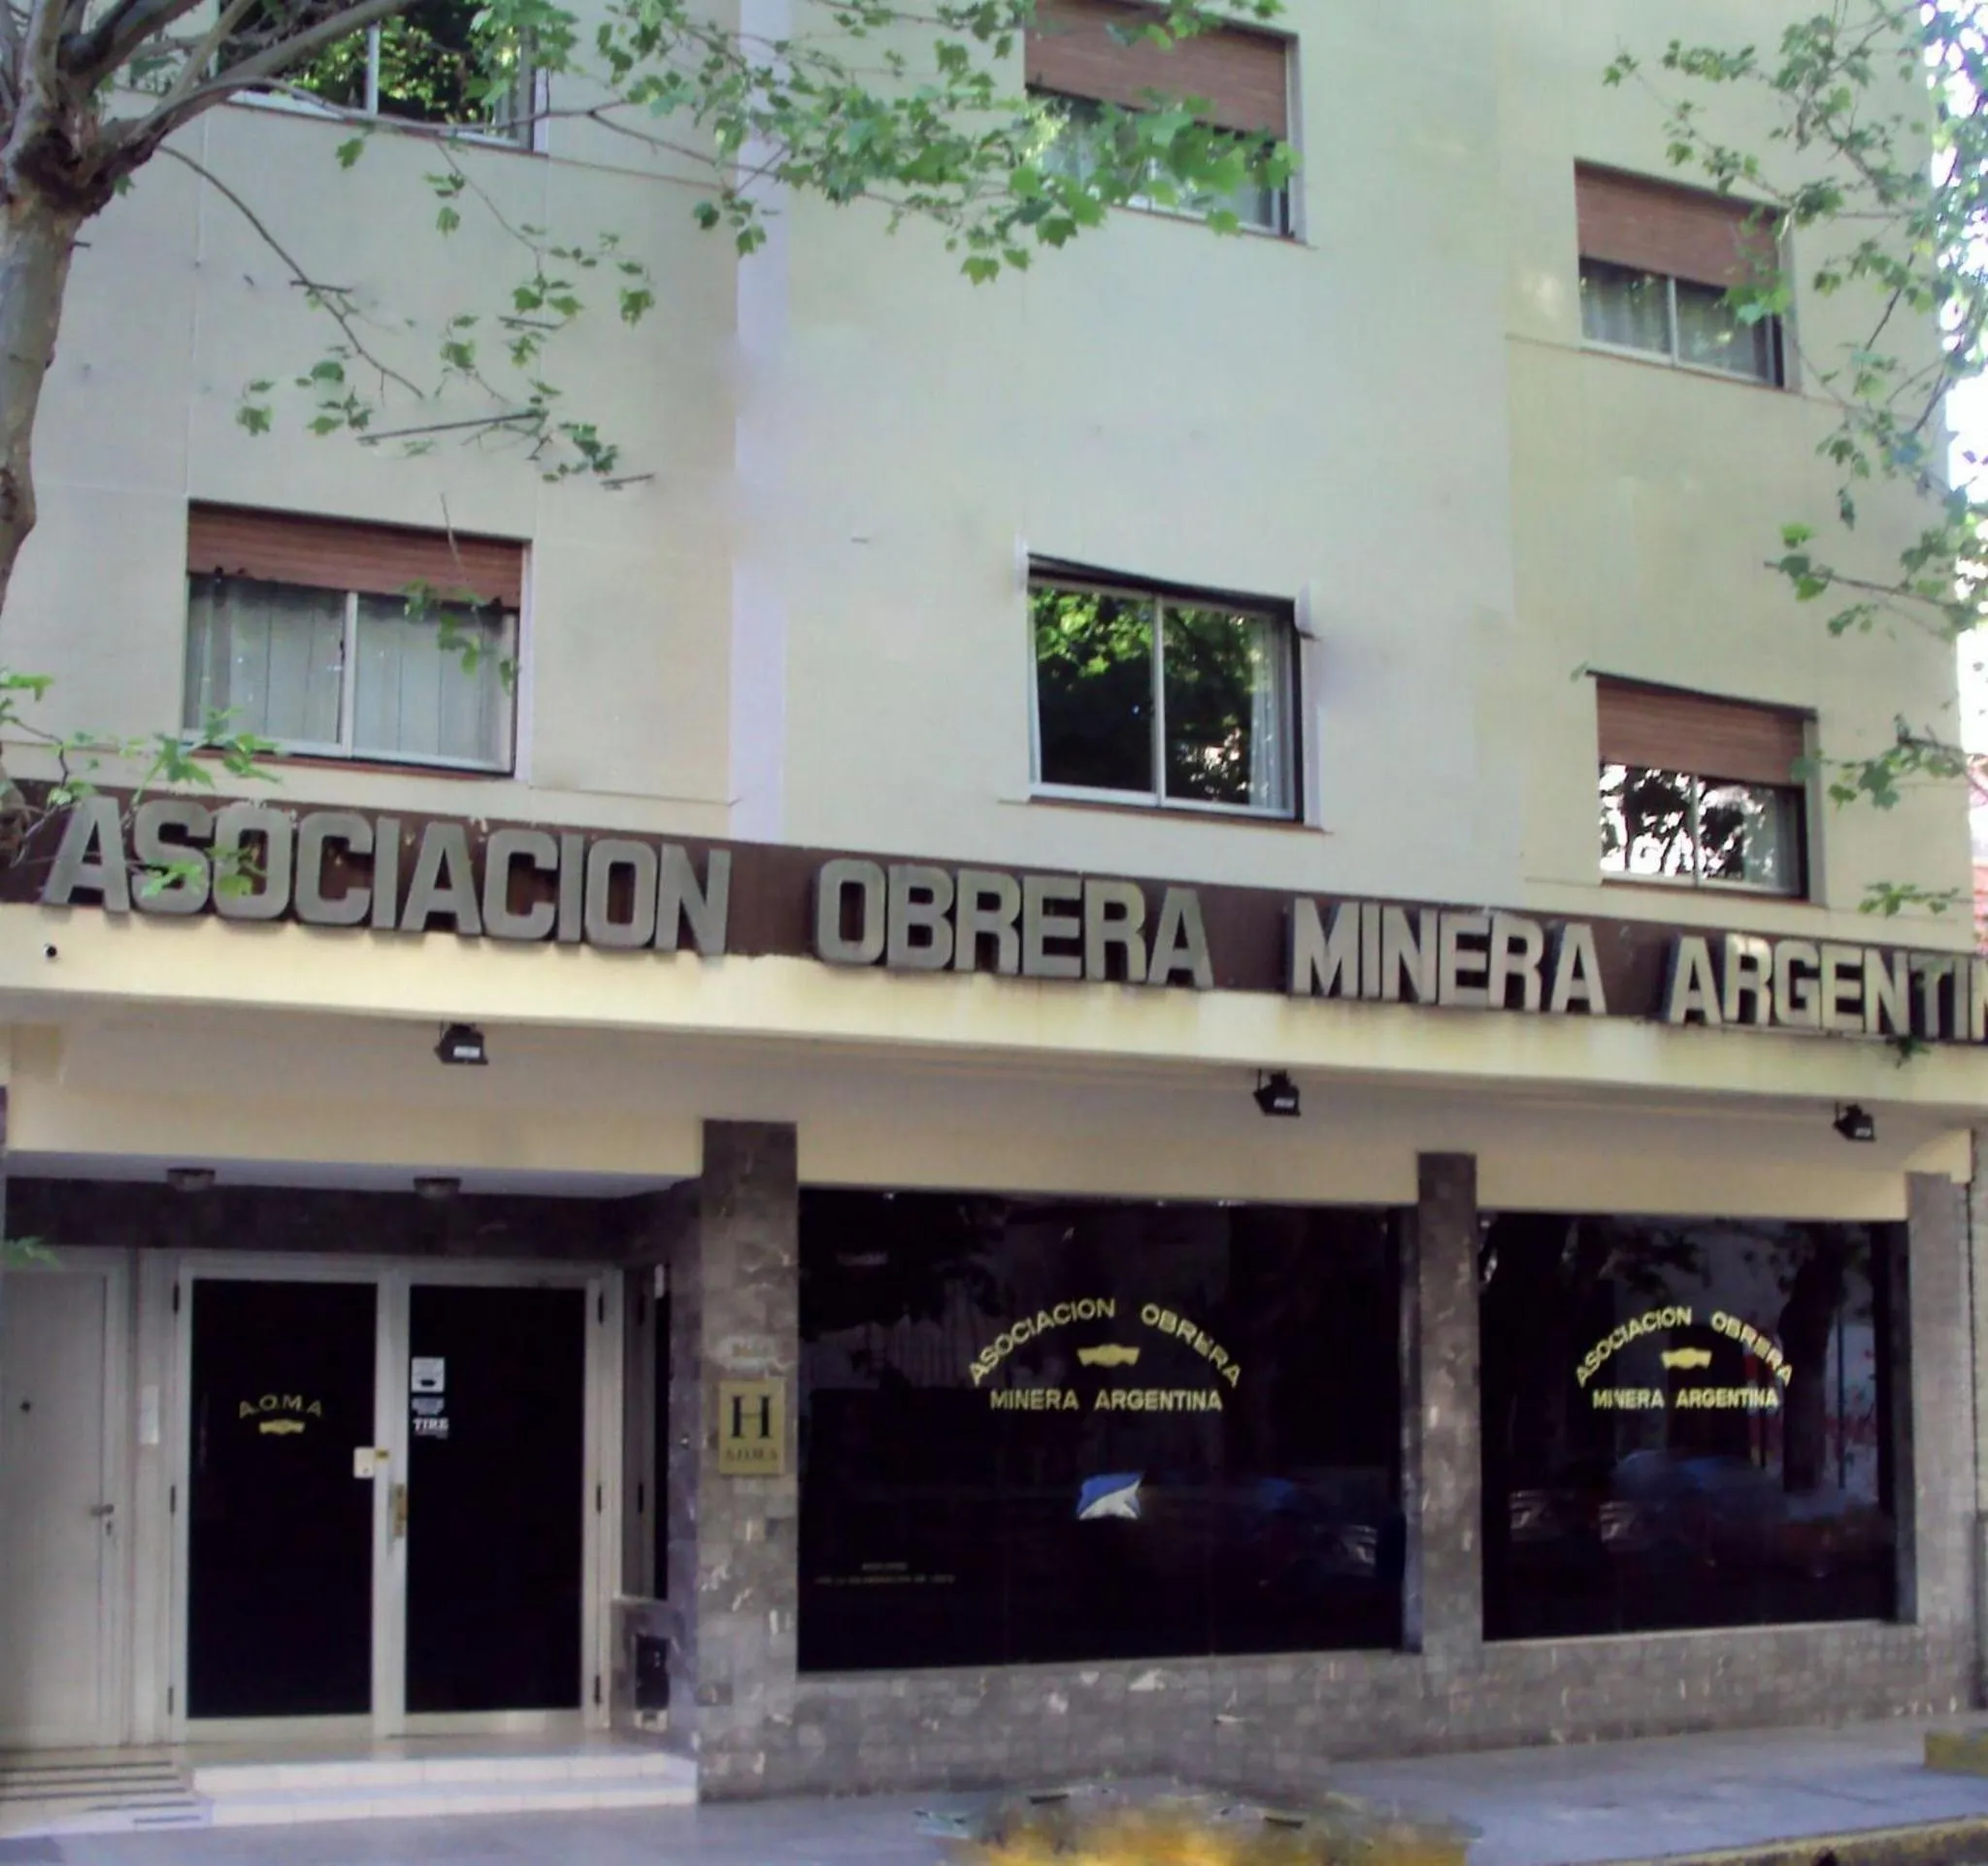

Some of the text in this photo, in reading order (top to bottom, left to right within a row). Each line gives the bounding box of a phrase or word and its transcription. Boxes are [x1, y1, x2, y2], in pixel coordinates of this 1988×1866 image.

[41, 795, 731, 955] ASOCIACION
[814, 857, 1213, 988] OBRERA
[1286, 897, 1607, 1015] MINERA
[969, 1298, 1242, 1388] ASOCIACION OBRERA
[1575, 1306, 1793, 1388] ASOCIACION OBRERA
[732, 1395, 773, 1438] H
[989, 1389, 1223, 1411] MINERA ARGENTINA
[1593, 1388, 1779, 1410] MINERA ARGENTINA
